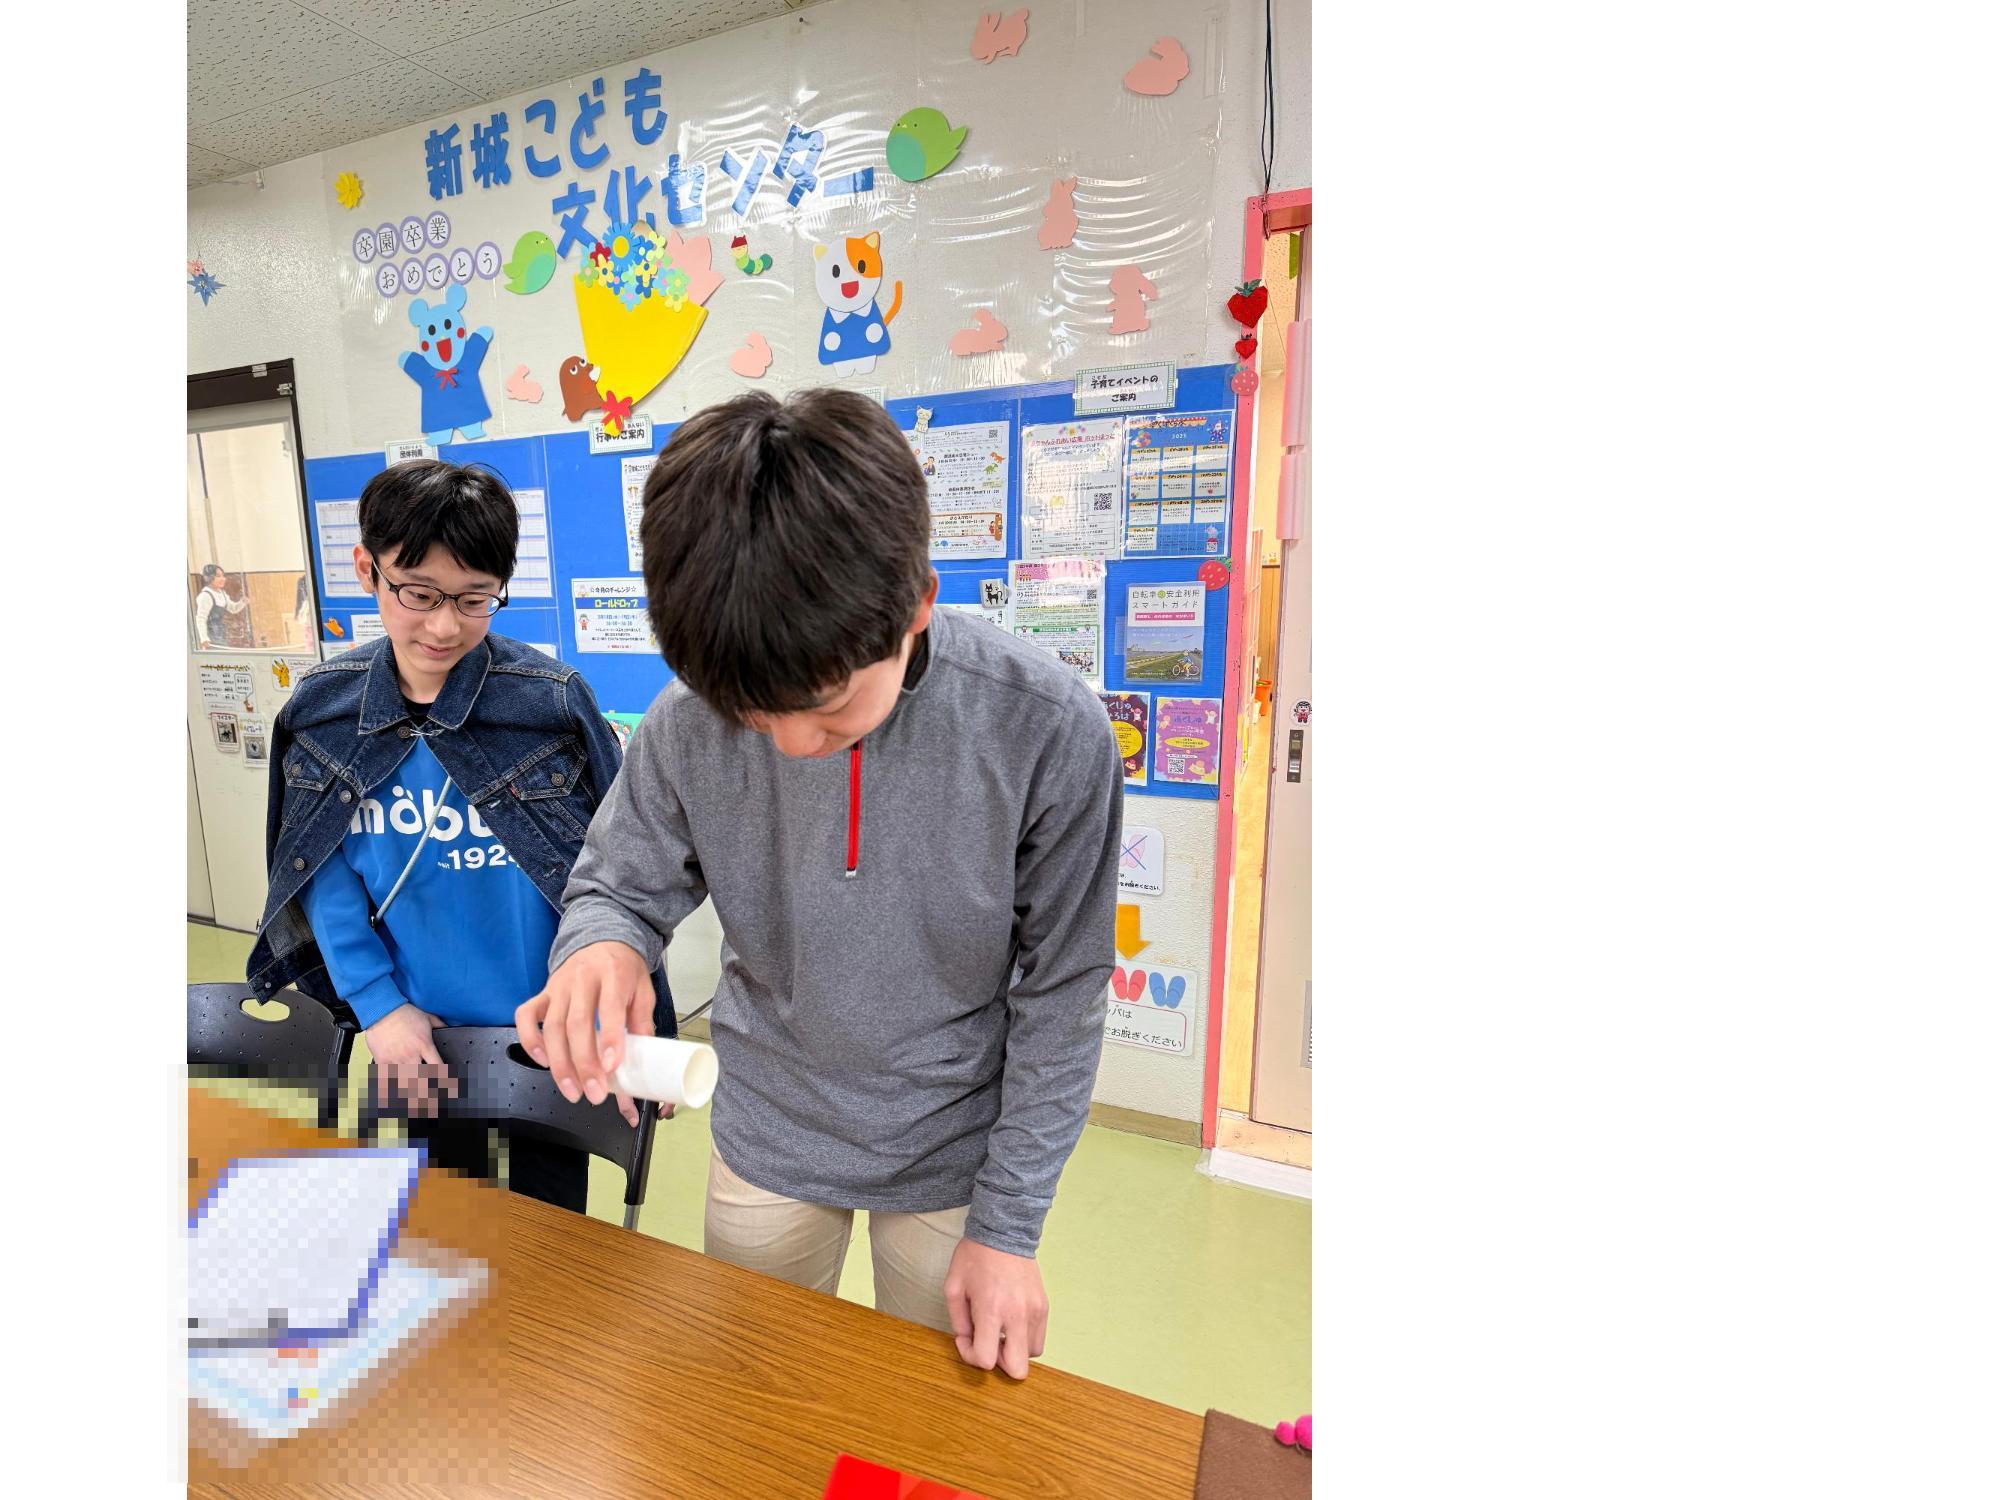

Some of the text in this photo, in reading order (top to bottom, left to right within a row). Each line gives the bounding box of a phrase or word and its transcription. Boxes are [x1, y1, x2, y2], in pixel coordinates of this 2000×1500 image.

[424, 67, 669, 200] 新城こども
[552, 122, 874, 260] 文化センター
[357, 214, 449, 256] 卒園卒業
[381, 246, 496, 291] おめでとう
[1090, 374, 1159, 389] 子育てイベントの
[1111, 392, 1137, 403] ご案内
[1132, 589, 1200, 599] 自転車の安全利用
[1132, 600, 1200, 609] スマートガイド
